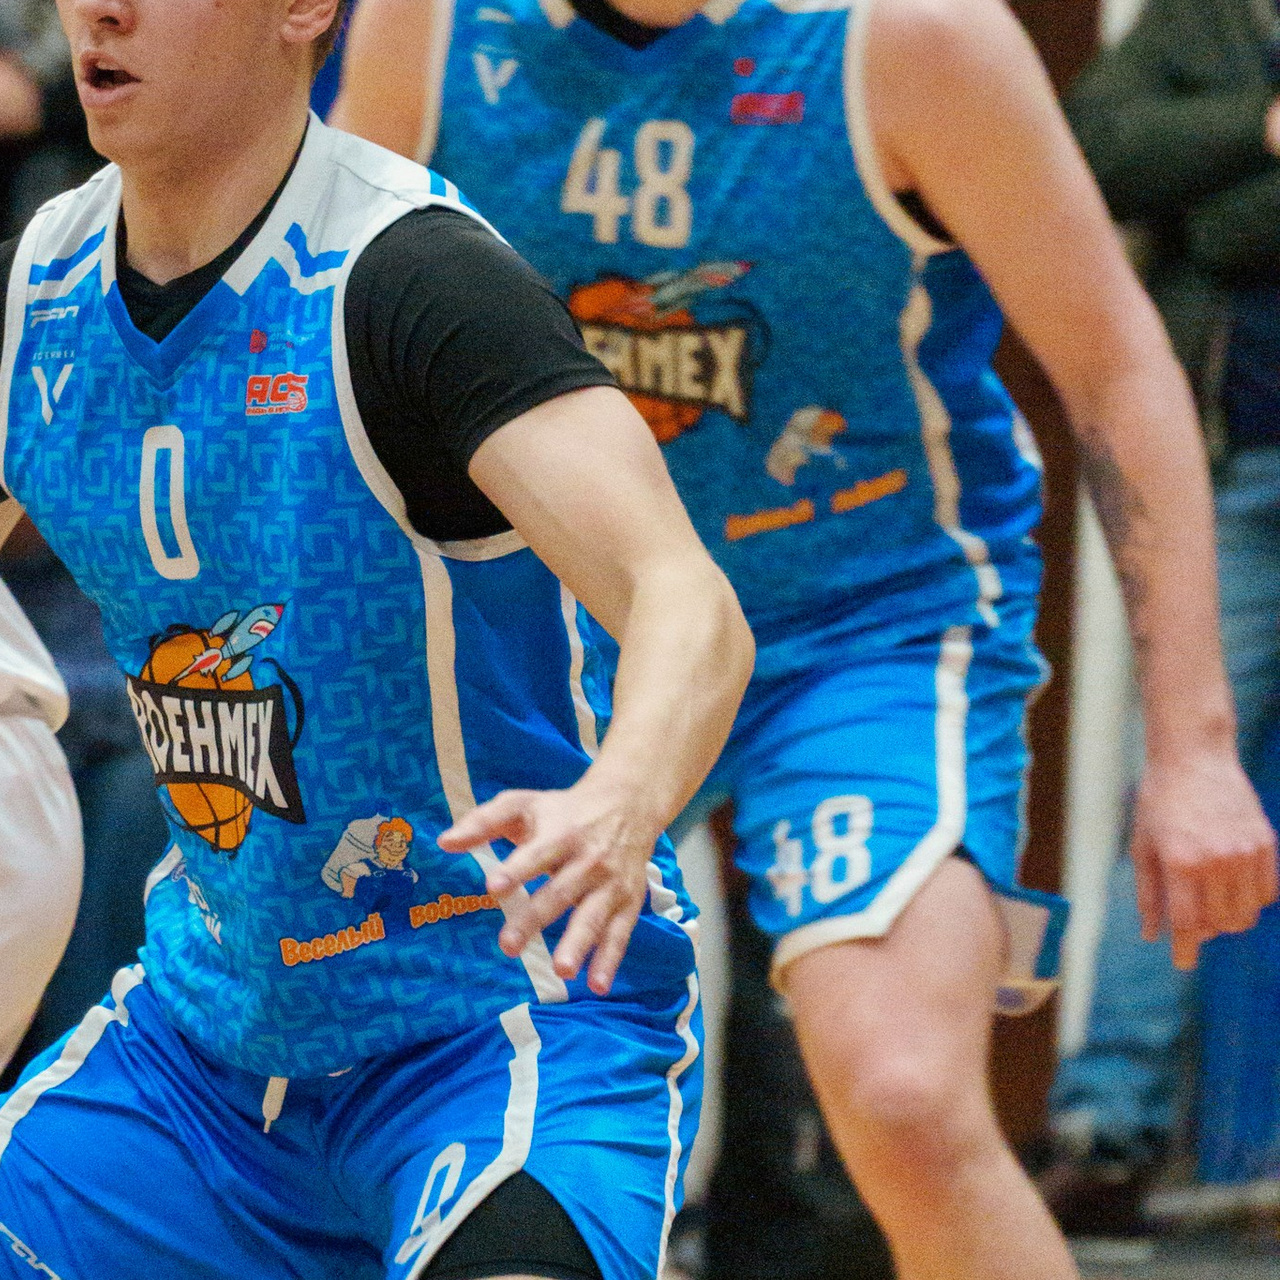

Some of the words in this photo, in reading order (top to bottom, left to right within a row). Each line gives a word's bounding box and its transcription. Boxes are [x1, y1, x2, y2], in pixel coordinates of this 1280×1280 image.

[560, 120, 694, 249] 48
[138, 425, 201, 580] 0
[279, 911, 386, 967] Веселый
[409, 893, 501, 929] водово
